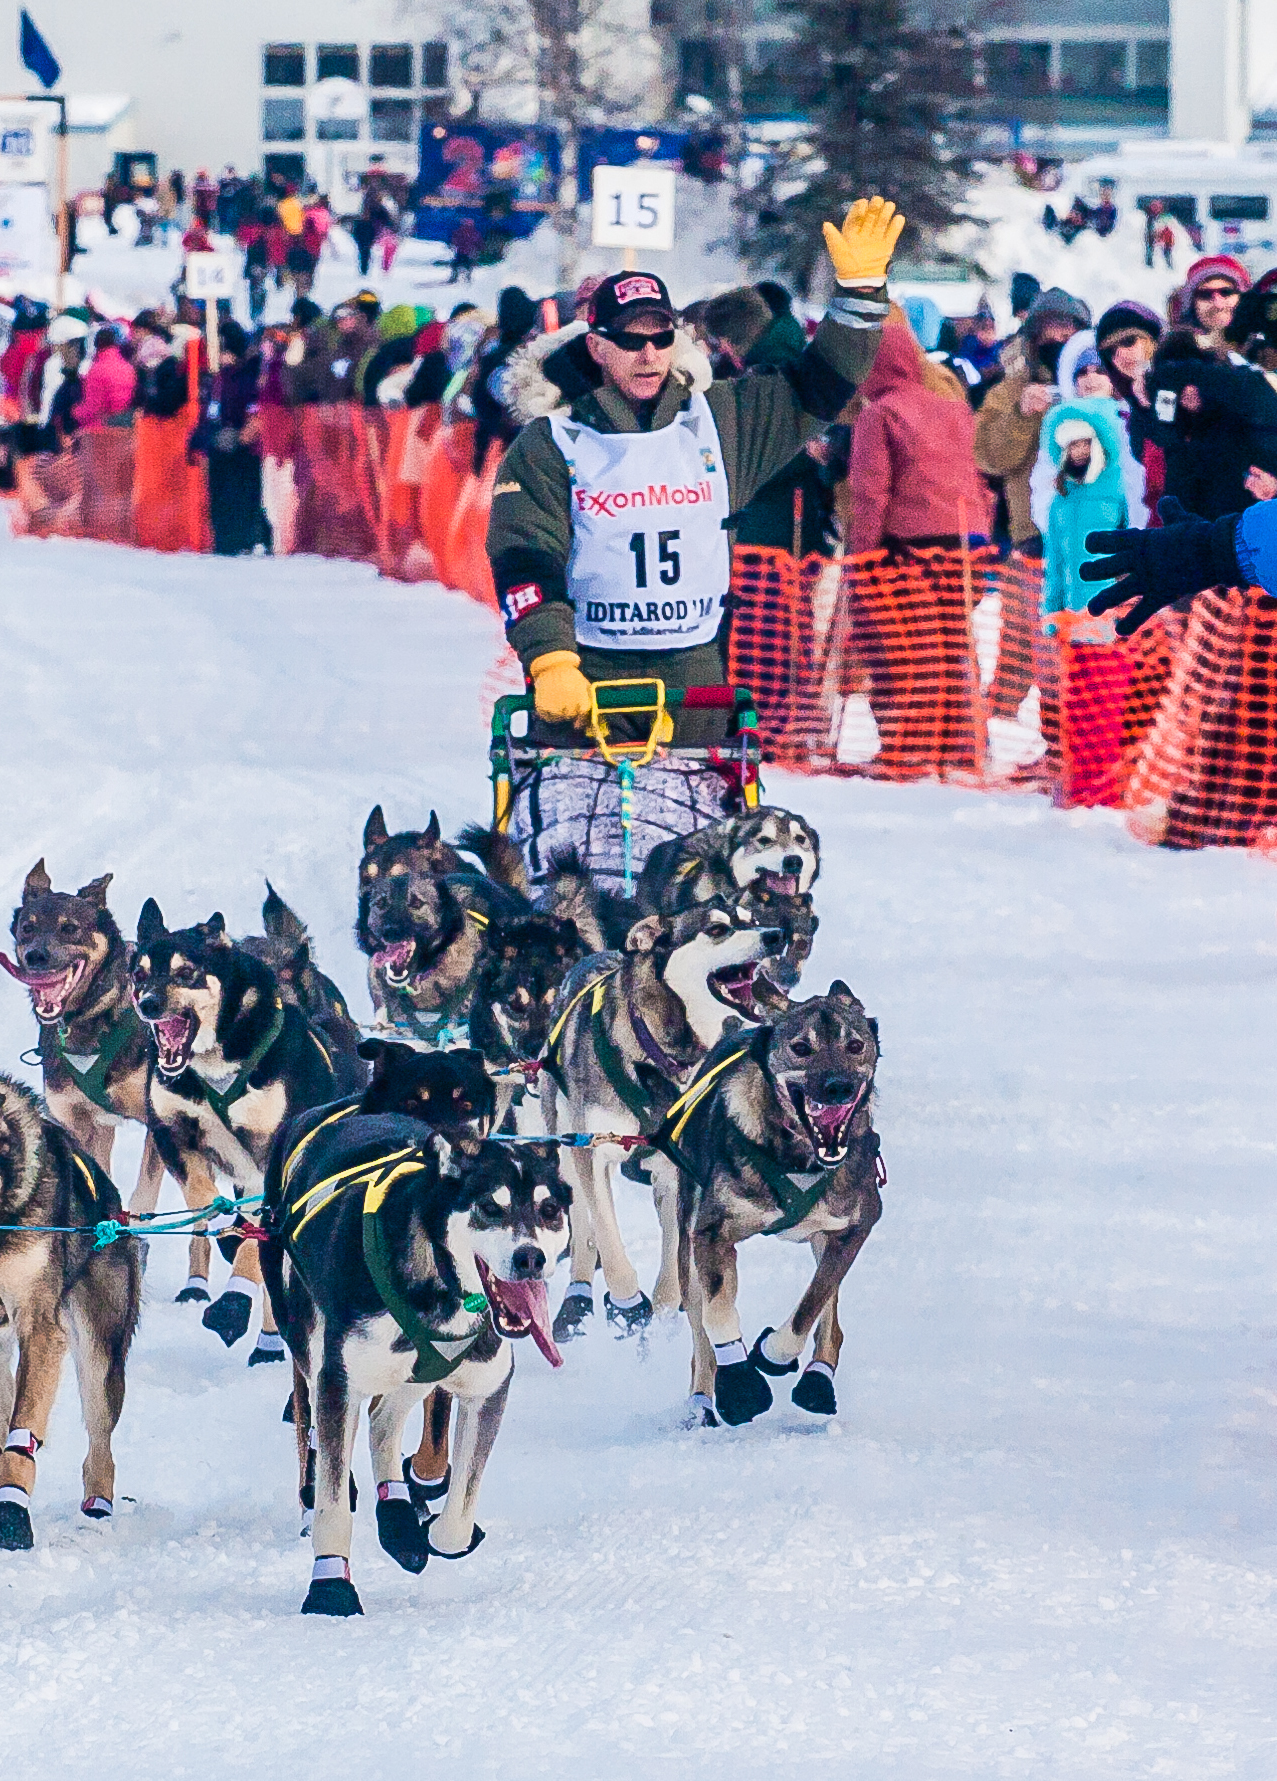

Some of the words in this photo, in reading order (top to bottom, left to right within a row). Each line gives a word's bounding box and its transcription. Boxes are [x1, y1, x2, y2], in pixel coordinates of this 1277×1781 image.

[609, 191, 660, 229] 15
[574, 481, 713, 518] ExxonMobil
[628, 529, 682, 589] 15
[585, 600, 688, 623] IDITAROD
